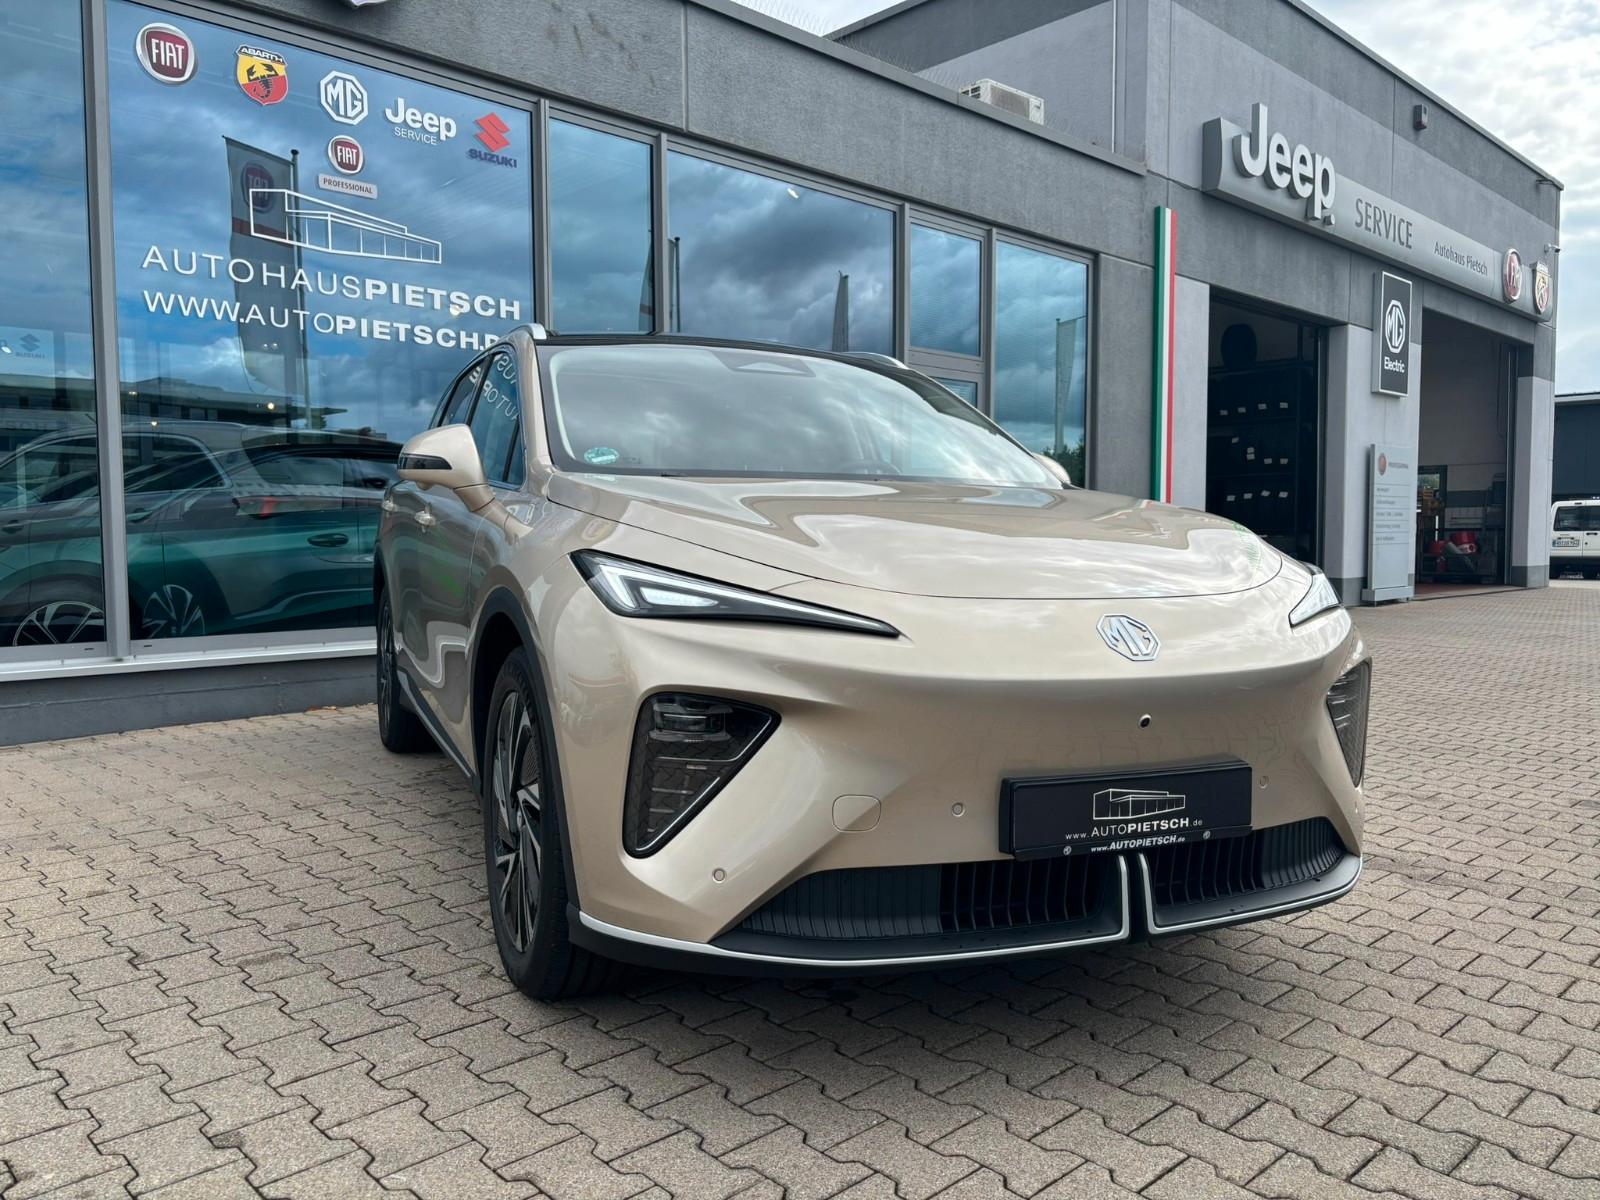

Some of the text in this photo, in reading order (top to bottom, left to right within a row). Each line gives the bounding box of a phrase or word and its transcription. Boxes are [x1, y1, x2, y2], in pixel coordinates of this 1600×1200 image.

[151, 38, 185, 70] FIAT
[240, 46, 284, 64] ABARTH
[325, 78, 363, 119] MG
[385, 97, 457, 142] Jeep
[394, 126, 438, 146] SERVICE
[336, 145, 358, 166] FIAT
[466, 148, 518, 169] SUZUKI
[322, 177, 374, 195] PROFESSIONAL
[1234, 102, 1413, 250] Jeep SERVICE
[1433, 241, 1466, 267] Autohaus
[1466, 255, 1489, 277] Pietsch
[142, 245, 521, 321] AUTOHAUSPIETSCH
[1387, 305, 1404, 347] MG
[1383, 356, 1405, 373] Electric
[1104, 616, 1157, 657] MG
